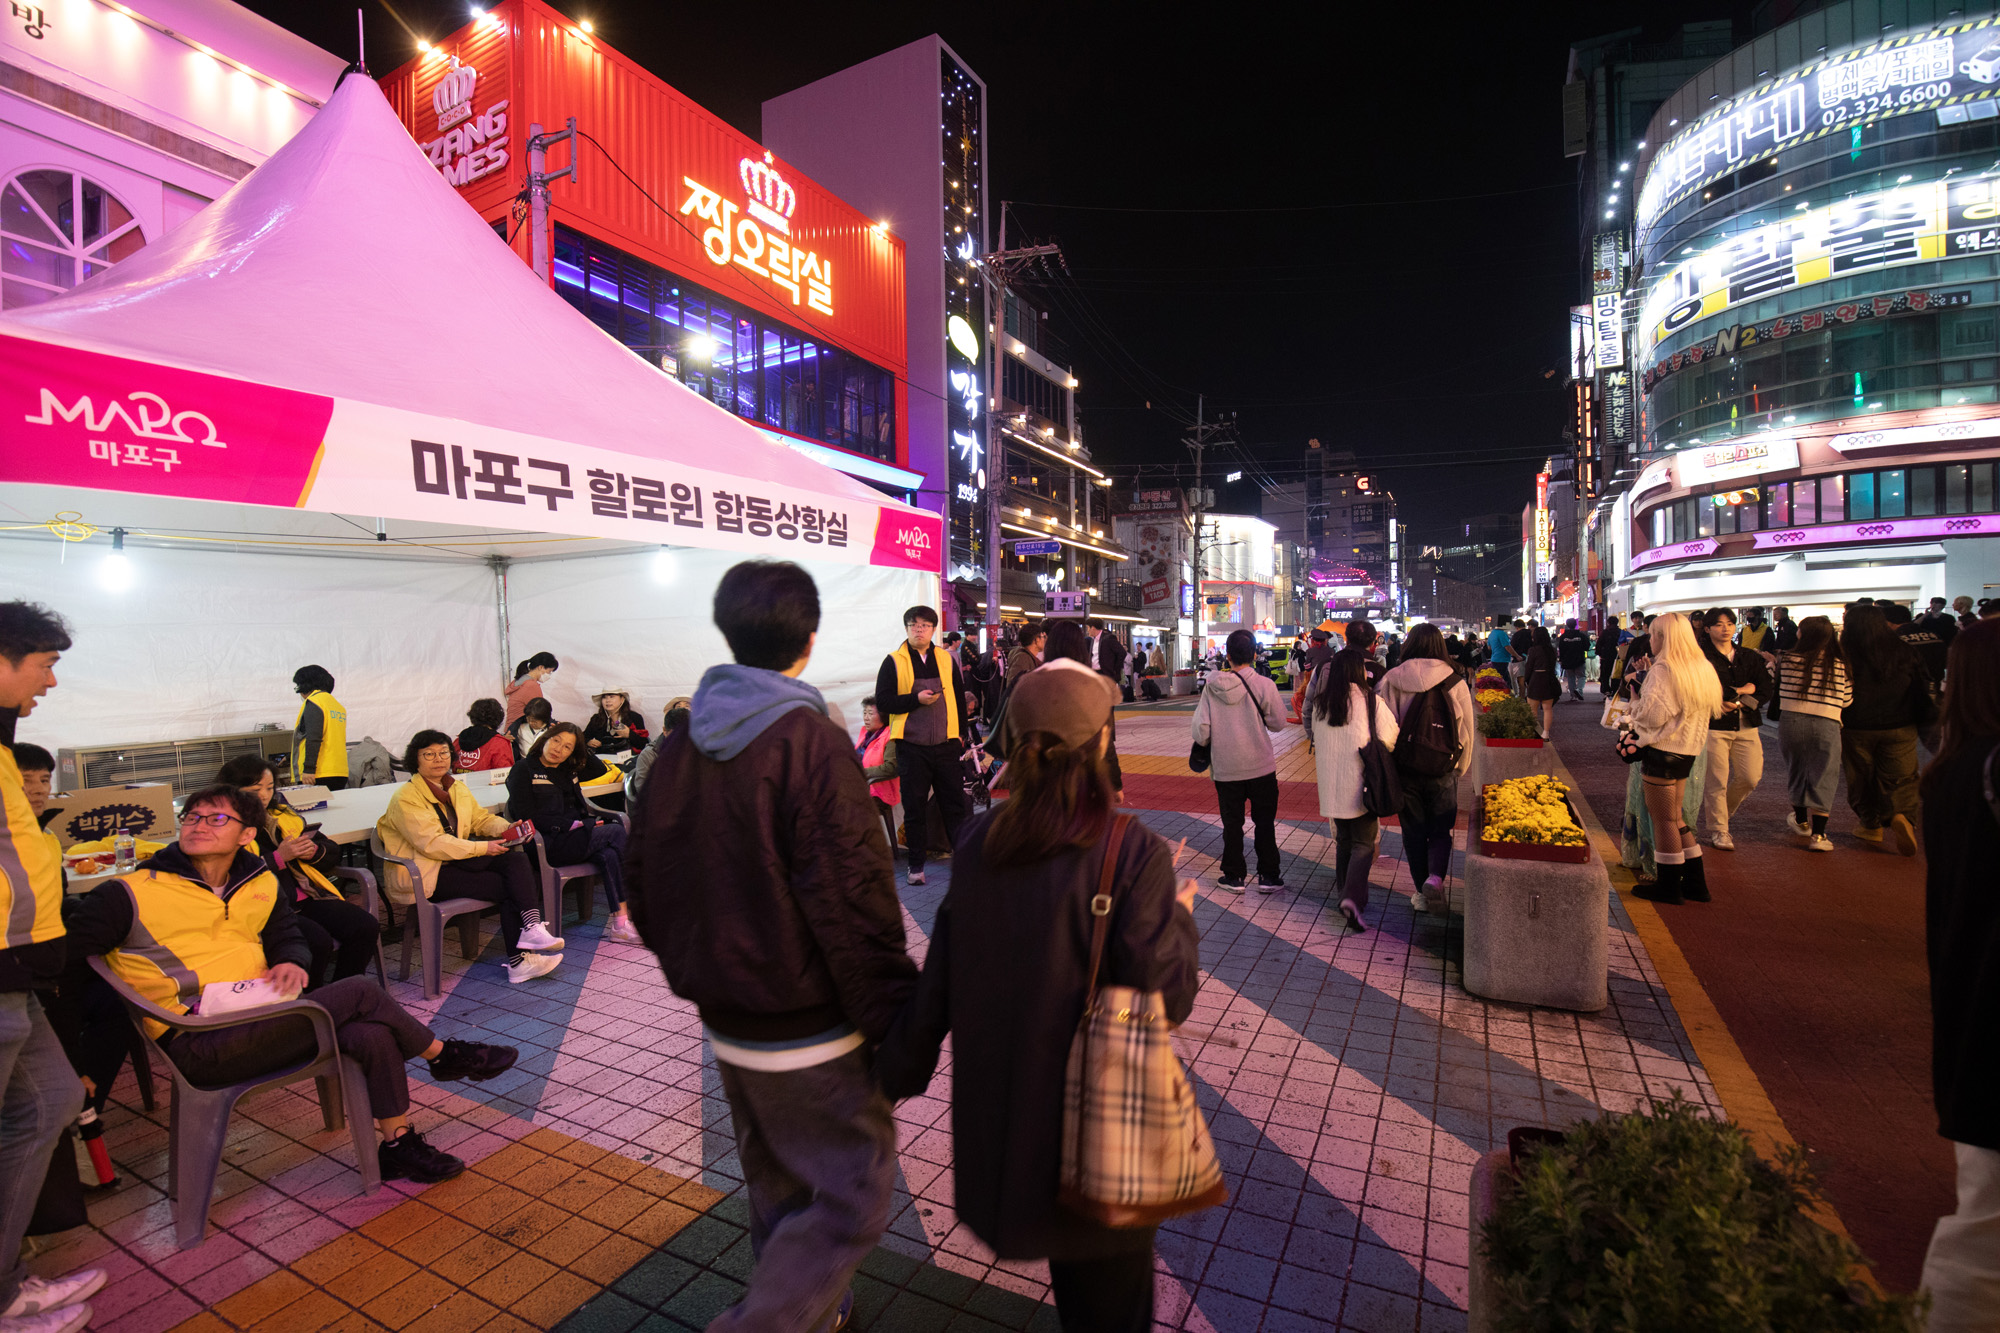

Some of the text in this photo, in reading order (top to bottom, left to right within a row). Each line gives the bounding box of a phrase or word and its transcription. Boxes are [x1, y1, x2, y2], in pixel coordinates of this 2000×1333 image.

[9, 0, 52, 40] 방
[1821, 59, 1950, 106] 병맥주/칵테일
[1822, 81, 1952, 126] 02.324.6600
[420, 99, 509, 168] ZANG
[679, 175, 834, 316] 짱오락실
[1597, 294, 1619, 366] 방탈출
[1715, 323, 1759, 357] N2
[1608, 371, 1627, 387] N2
[25, 387, 228, 449] MAPO
[88, 439, 182, 473] 마포구
[410, 439, 849, 549] 마포구 할로윈 합동상황실
[1141, 491, 1172, 502] 부동산
[1356, 477, 1369, 490] G
[895, 526, 931, 549] MAPO
[1538, 510, 1546, 549] TATTOO
[1149, 590, 1165, 601] TACO
[1331, 611, 1353, 619] BEER
[79, 810, 146, 832] 박카스
